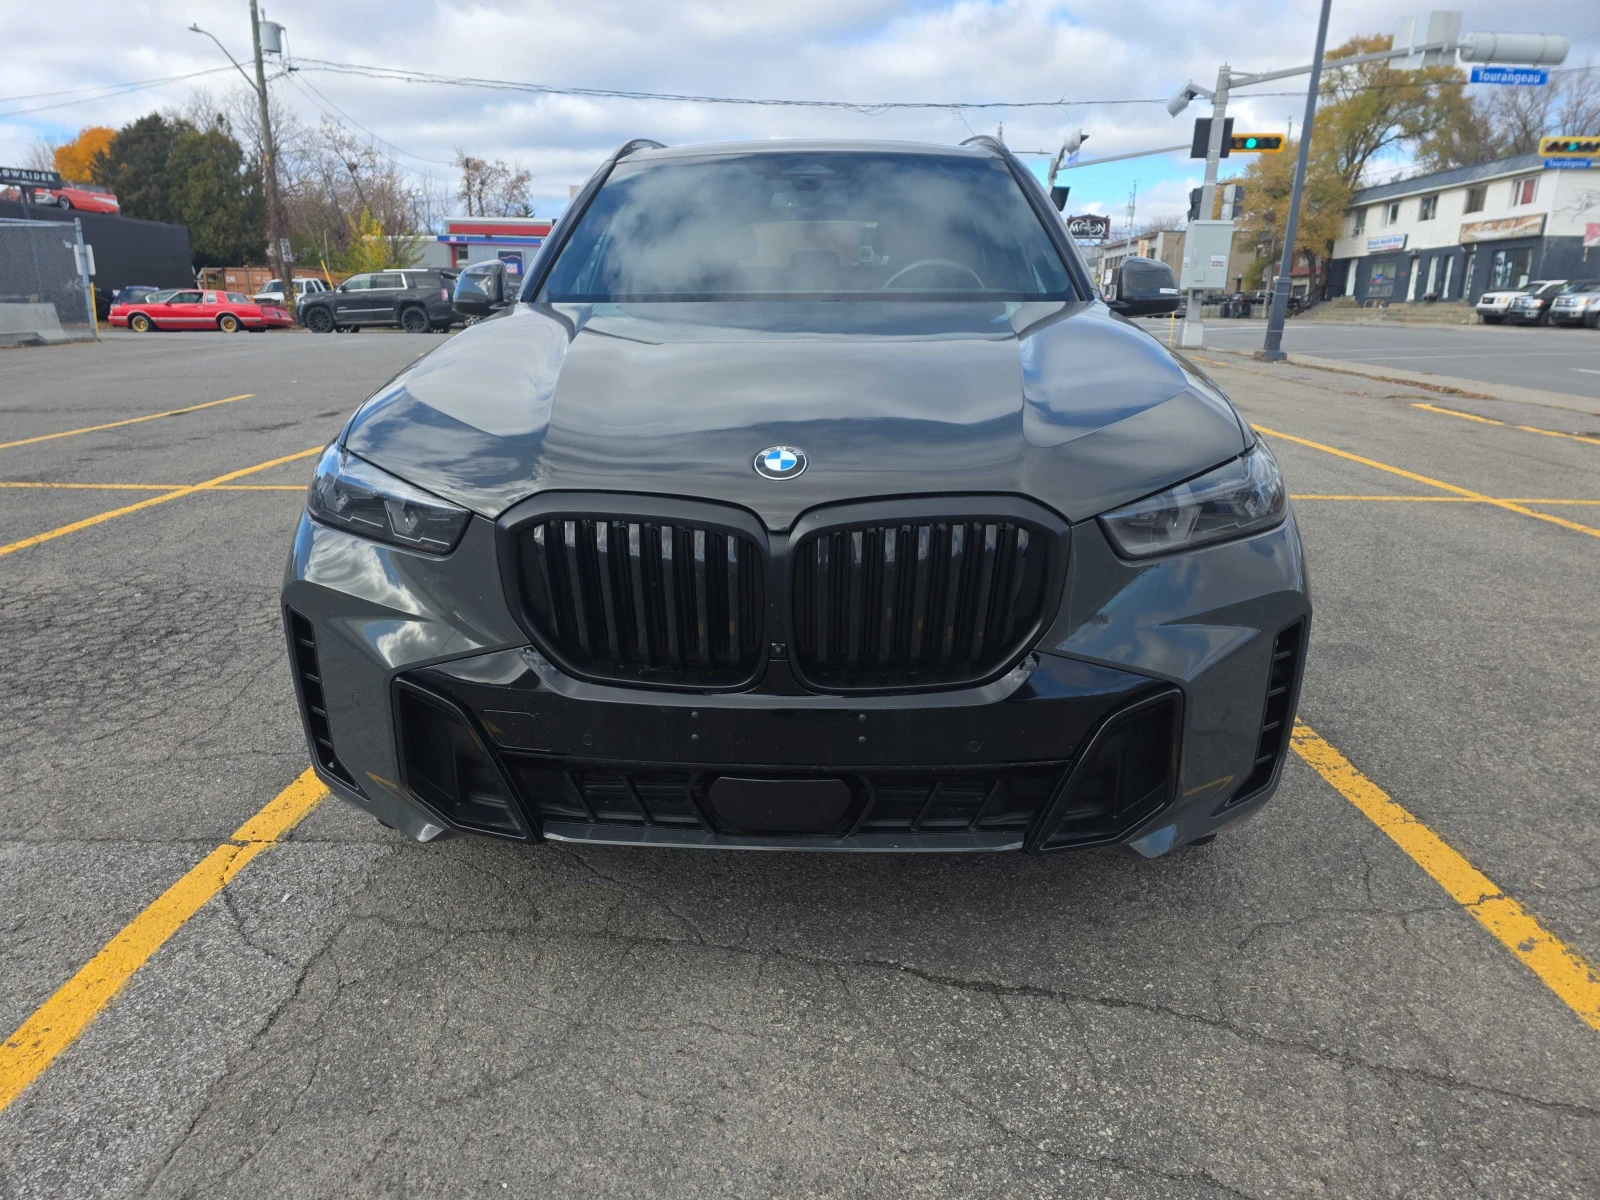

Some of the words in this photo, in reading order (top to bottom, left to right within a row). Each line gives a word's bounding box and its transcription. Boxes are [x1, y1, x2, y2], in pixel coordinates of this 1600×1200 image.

[1479, 70, 1541, 84] Tourangeau
[0, 168, 55, 182] OWRIDER
[760, 446, 804, 456] BMW
